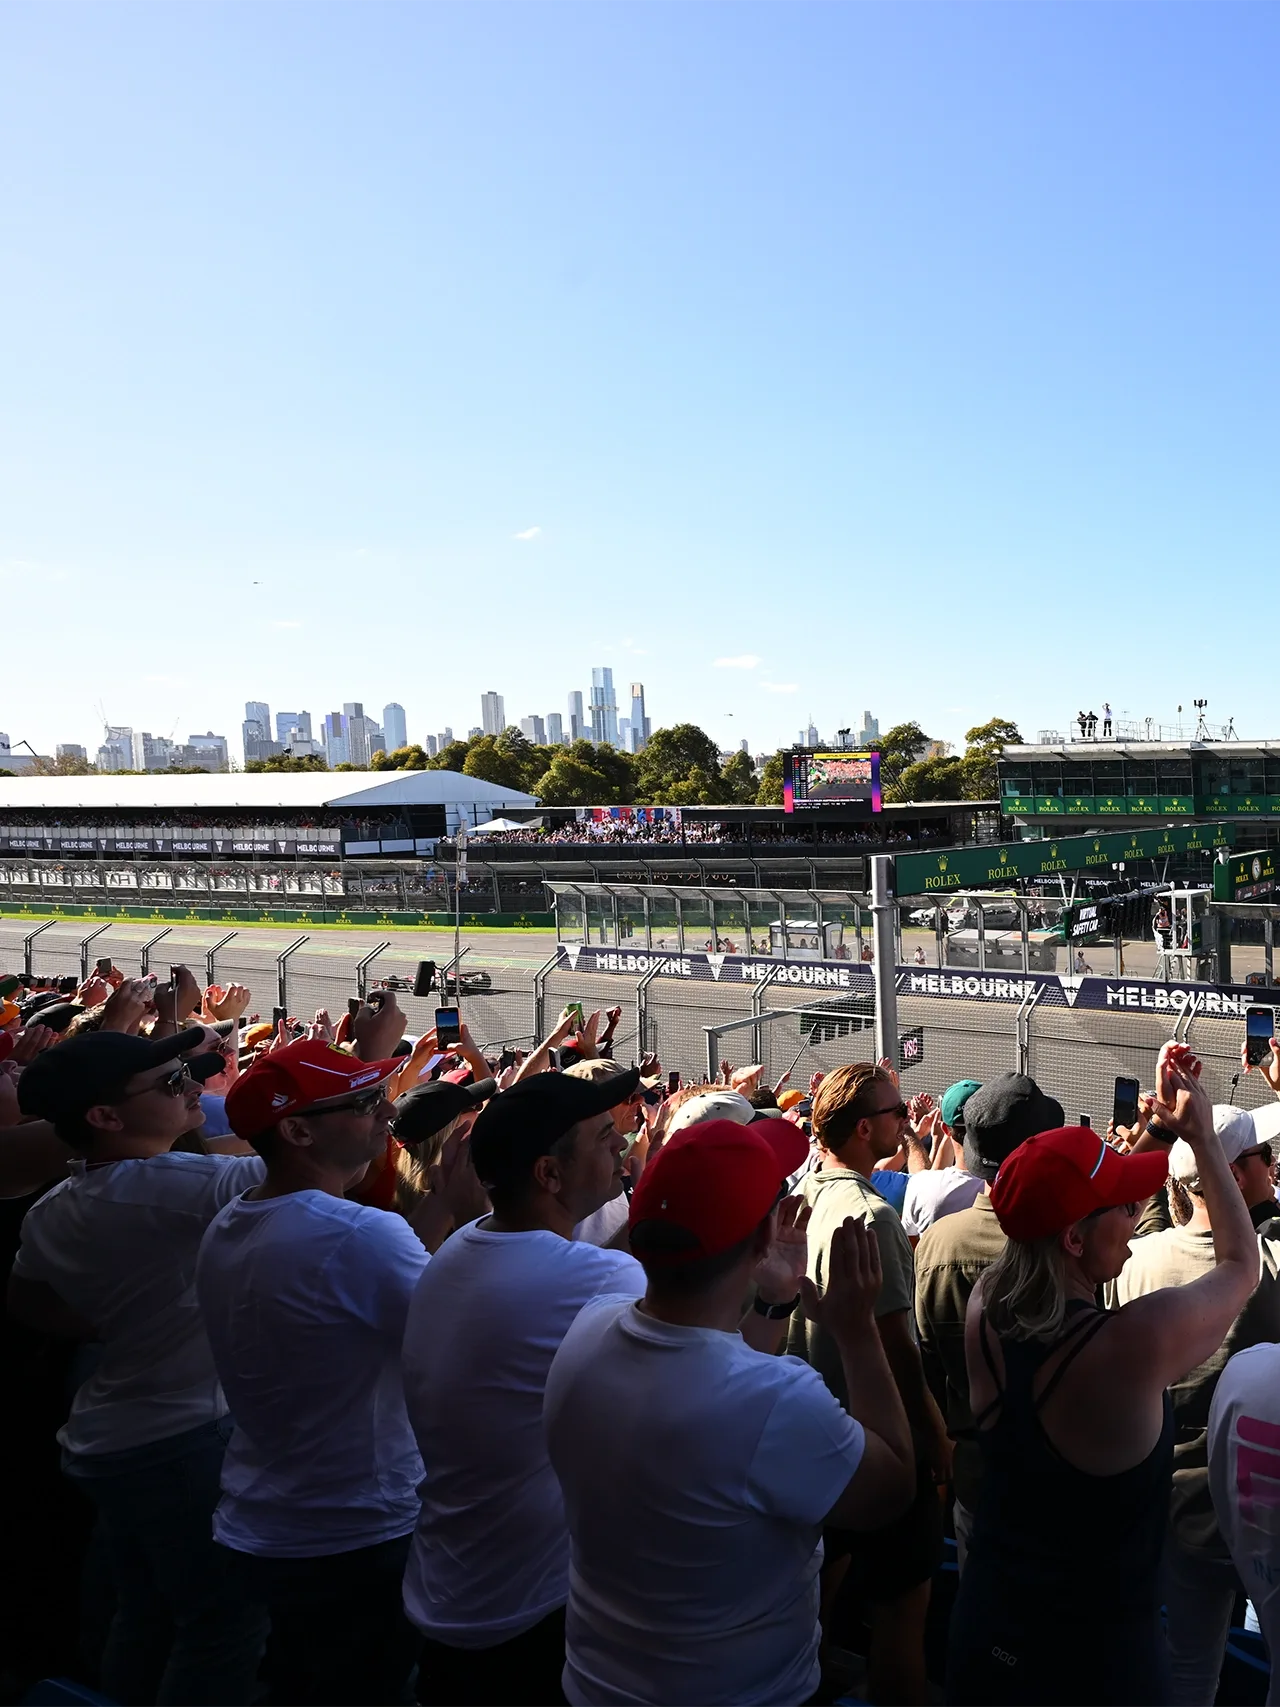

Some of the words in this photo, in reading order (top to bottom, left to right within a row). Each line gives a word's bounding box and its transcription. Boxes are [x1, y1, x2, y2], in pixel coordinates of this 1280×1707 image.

[1187, 840, 1203, 849] ROLEX
[1212, 837, 1227, 846] ROLEX
[1124, 848, 1144, 859] ROLEX
[1157, 844, 1175, 854] ROLEX
[1041, 859, 1067, 872] ROLEX
[1086, 853, 1108, 865] ROLEX
[988, 866, 1018, 880] ROLEX
[925, 874, 961, 889] ROLEX
[1072, 921, 1090, 936] SAFETY
[1089, 919, 1099, 932] CAR
[1106, 985, 1254, 1014] MELBOURNE
[903, 1037, 918, 1059] VSC
